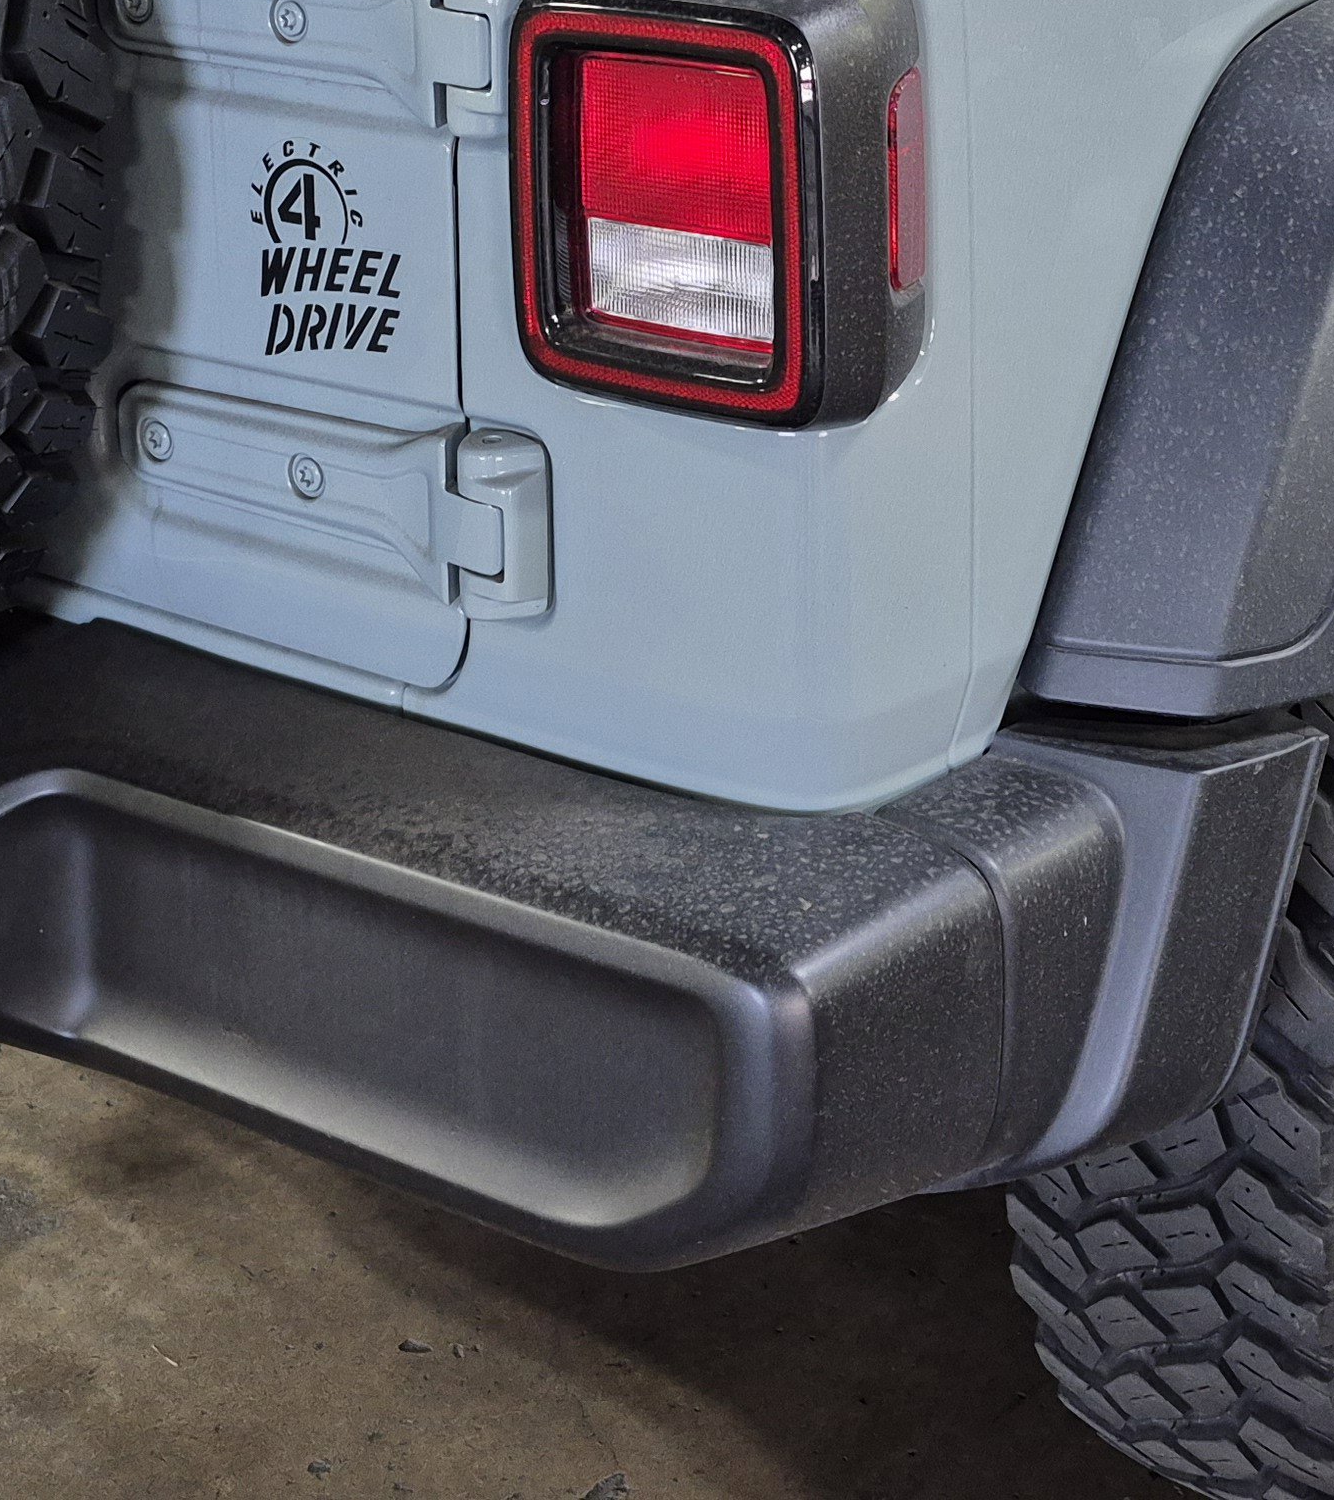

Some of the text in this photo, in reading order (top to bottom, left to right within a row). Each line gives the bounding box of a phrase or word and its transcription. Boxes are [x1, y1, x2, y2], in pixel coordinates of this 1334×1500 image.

[250, 140, 363, 228] ELECTRIC
[277, 173, 321, 241] 4
[261, 246, 402, 298] WHEEL
[265, 303, 401, 356] DRIVE
